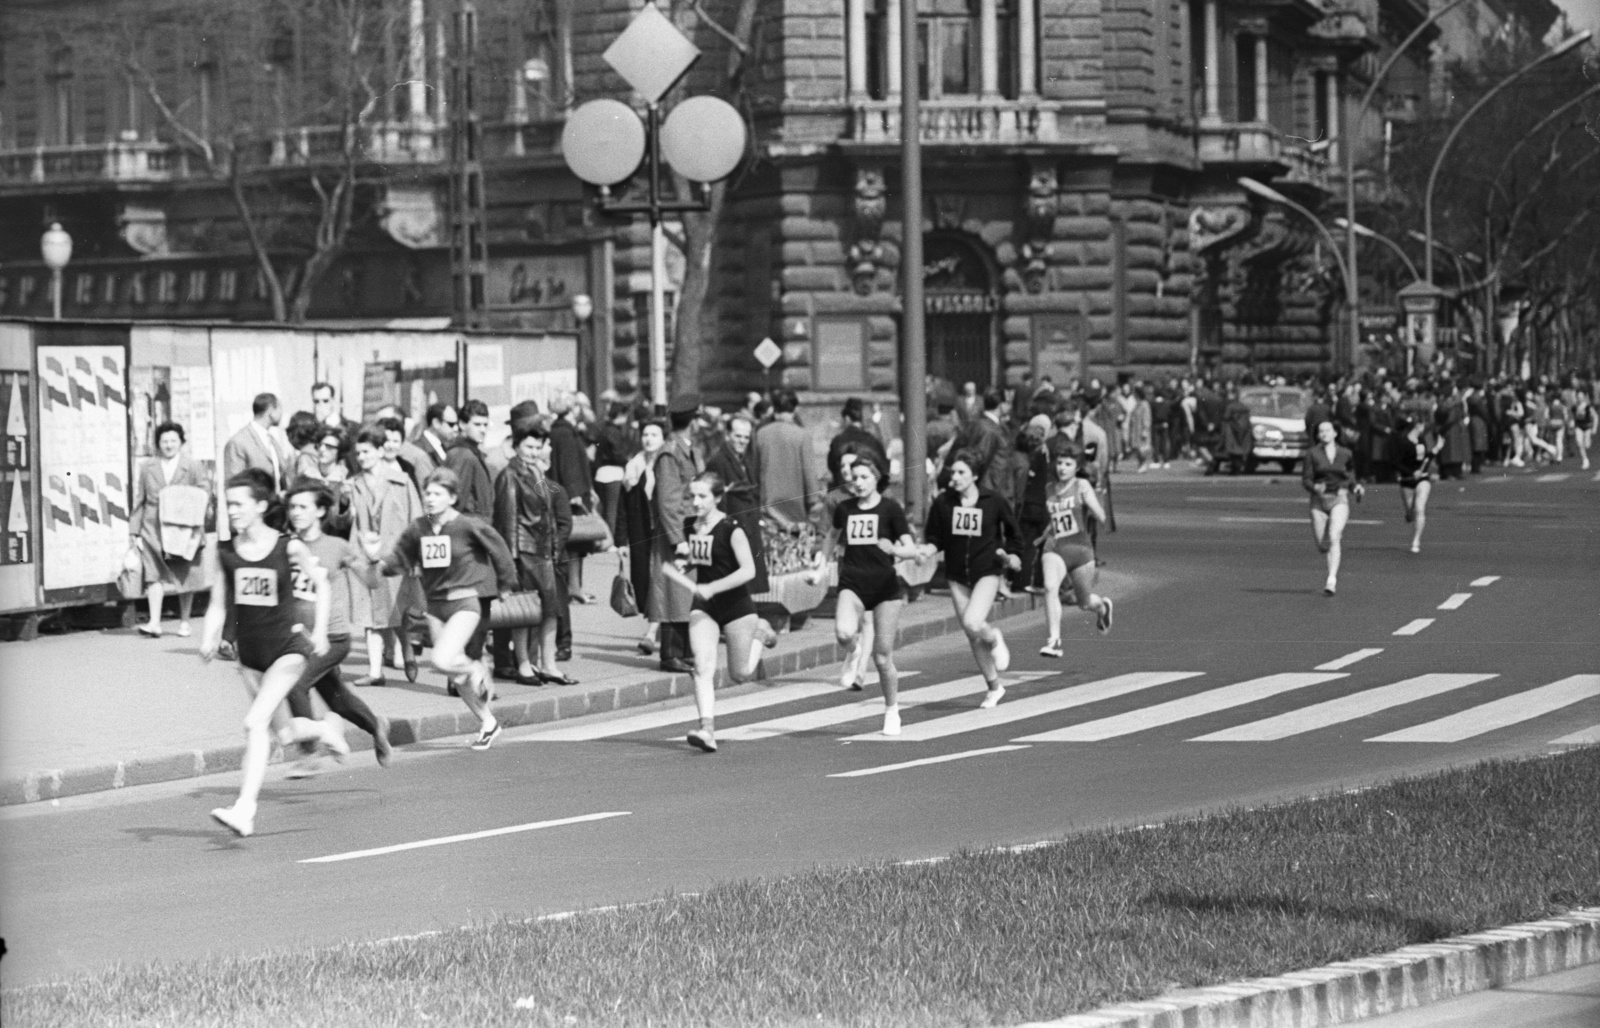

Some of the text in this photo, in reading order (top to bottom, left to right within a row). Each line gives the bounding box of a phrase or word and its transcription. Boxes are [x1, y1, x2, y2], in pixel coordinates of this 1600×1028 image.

[851, 519, 874, 539] 229
[956, 512, 979, 531] 205
[1053, 514, 1072, 533] 217
[426, 543, 446, 560] 220
